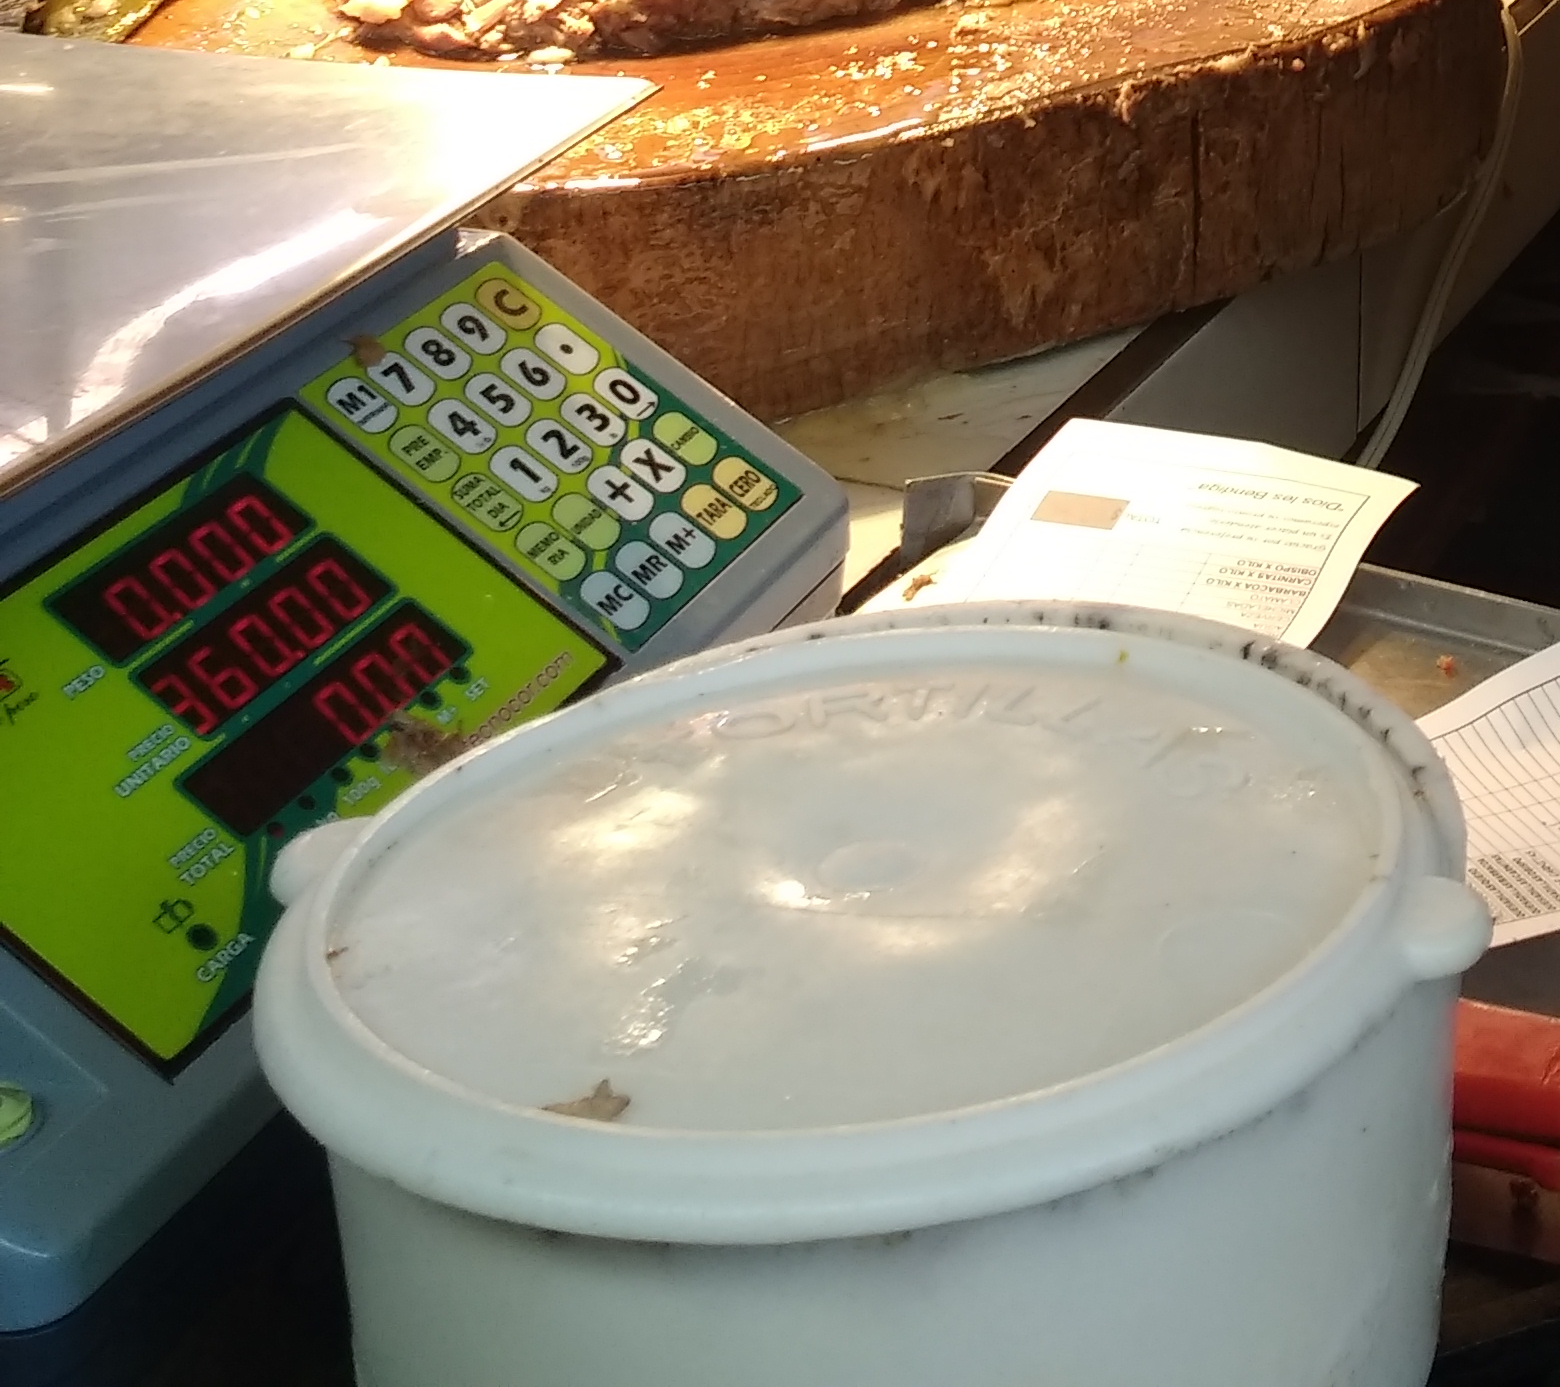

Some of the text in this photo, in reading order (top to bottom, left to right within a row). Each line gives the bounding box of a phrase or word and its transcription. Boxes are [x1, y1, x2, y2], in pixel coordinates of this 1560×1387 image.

[336, 383, 378, 415] M1
[379, 361, 415, 394] 7
[420, 337, 455, 366] 8
[458, 313, 490, 341] 9
[494, 287, 527, 315] C
[447, 359, 550, 436] 4 5 6
[509, 377, 639, 484] 1 2 3 0
[401, 434, 429, 456] PRE
[453, 476, 485, 500] SUMA
[466, 484, 502, 511] TOTAL
[1272, 492, 1298, 504] les
[487, 501, 509, 519] DIA
[526, 530, 561, 558] MEMO
[596, 468, 761, 617] MC MR M+ TARA CERO
[99, 493, 294, 641] 0.000
[1218, 566, 1245, 576] KILO
[1236, 558, 1263, 568] KILO
[1274, 563, 1317, 576] OBISPO
[1205, 576, 1231, 587] KILO
[1243, 581, 1306, 597] BARBACOA
[1257, 571, 1311, 585] CARNITAS
[61, 663, 106, 701] PESO
[463, 676, 491, 702] SET
[126, 720, 176, 762] PRECIO
[113, 733, 192, 799] UNITARIO
[168, 826, 218, 869] PRECIO
[177, 840, 235, 887] TOTAL
[193, 932, 255, 984] CARGA
